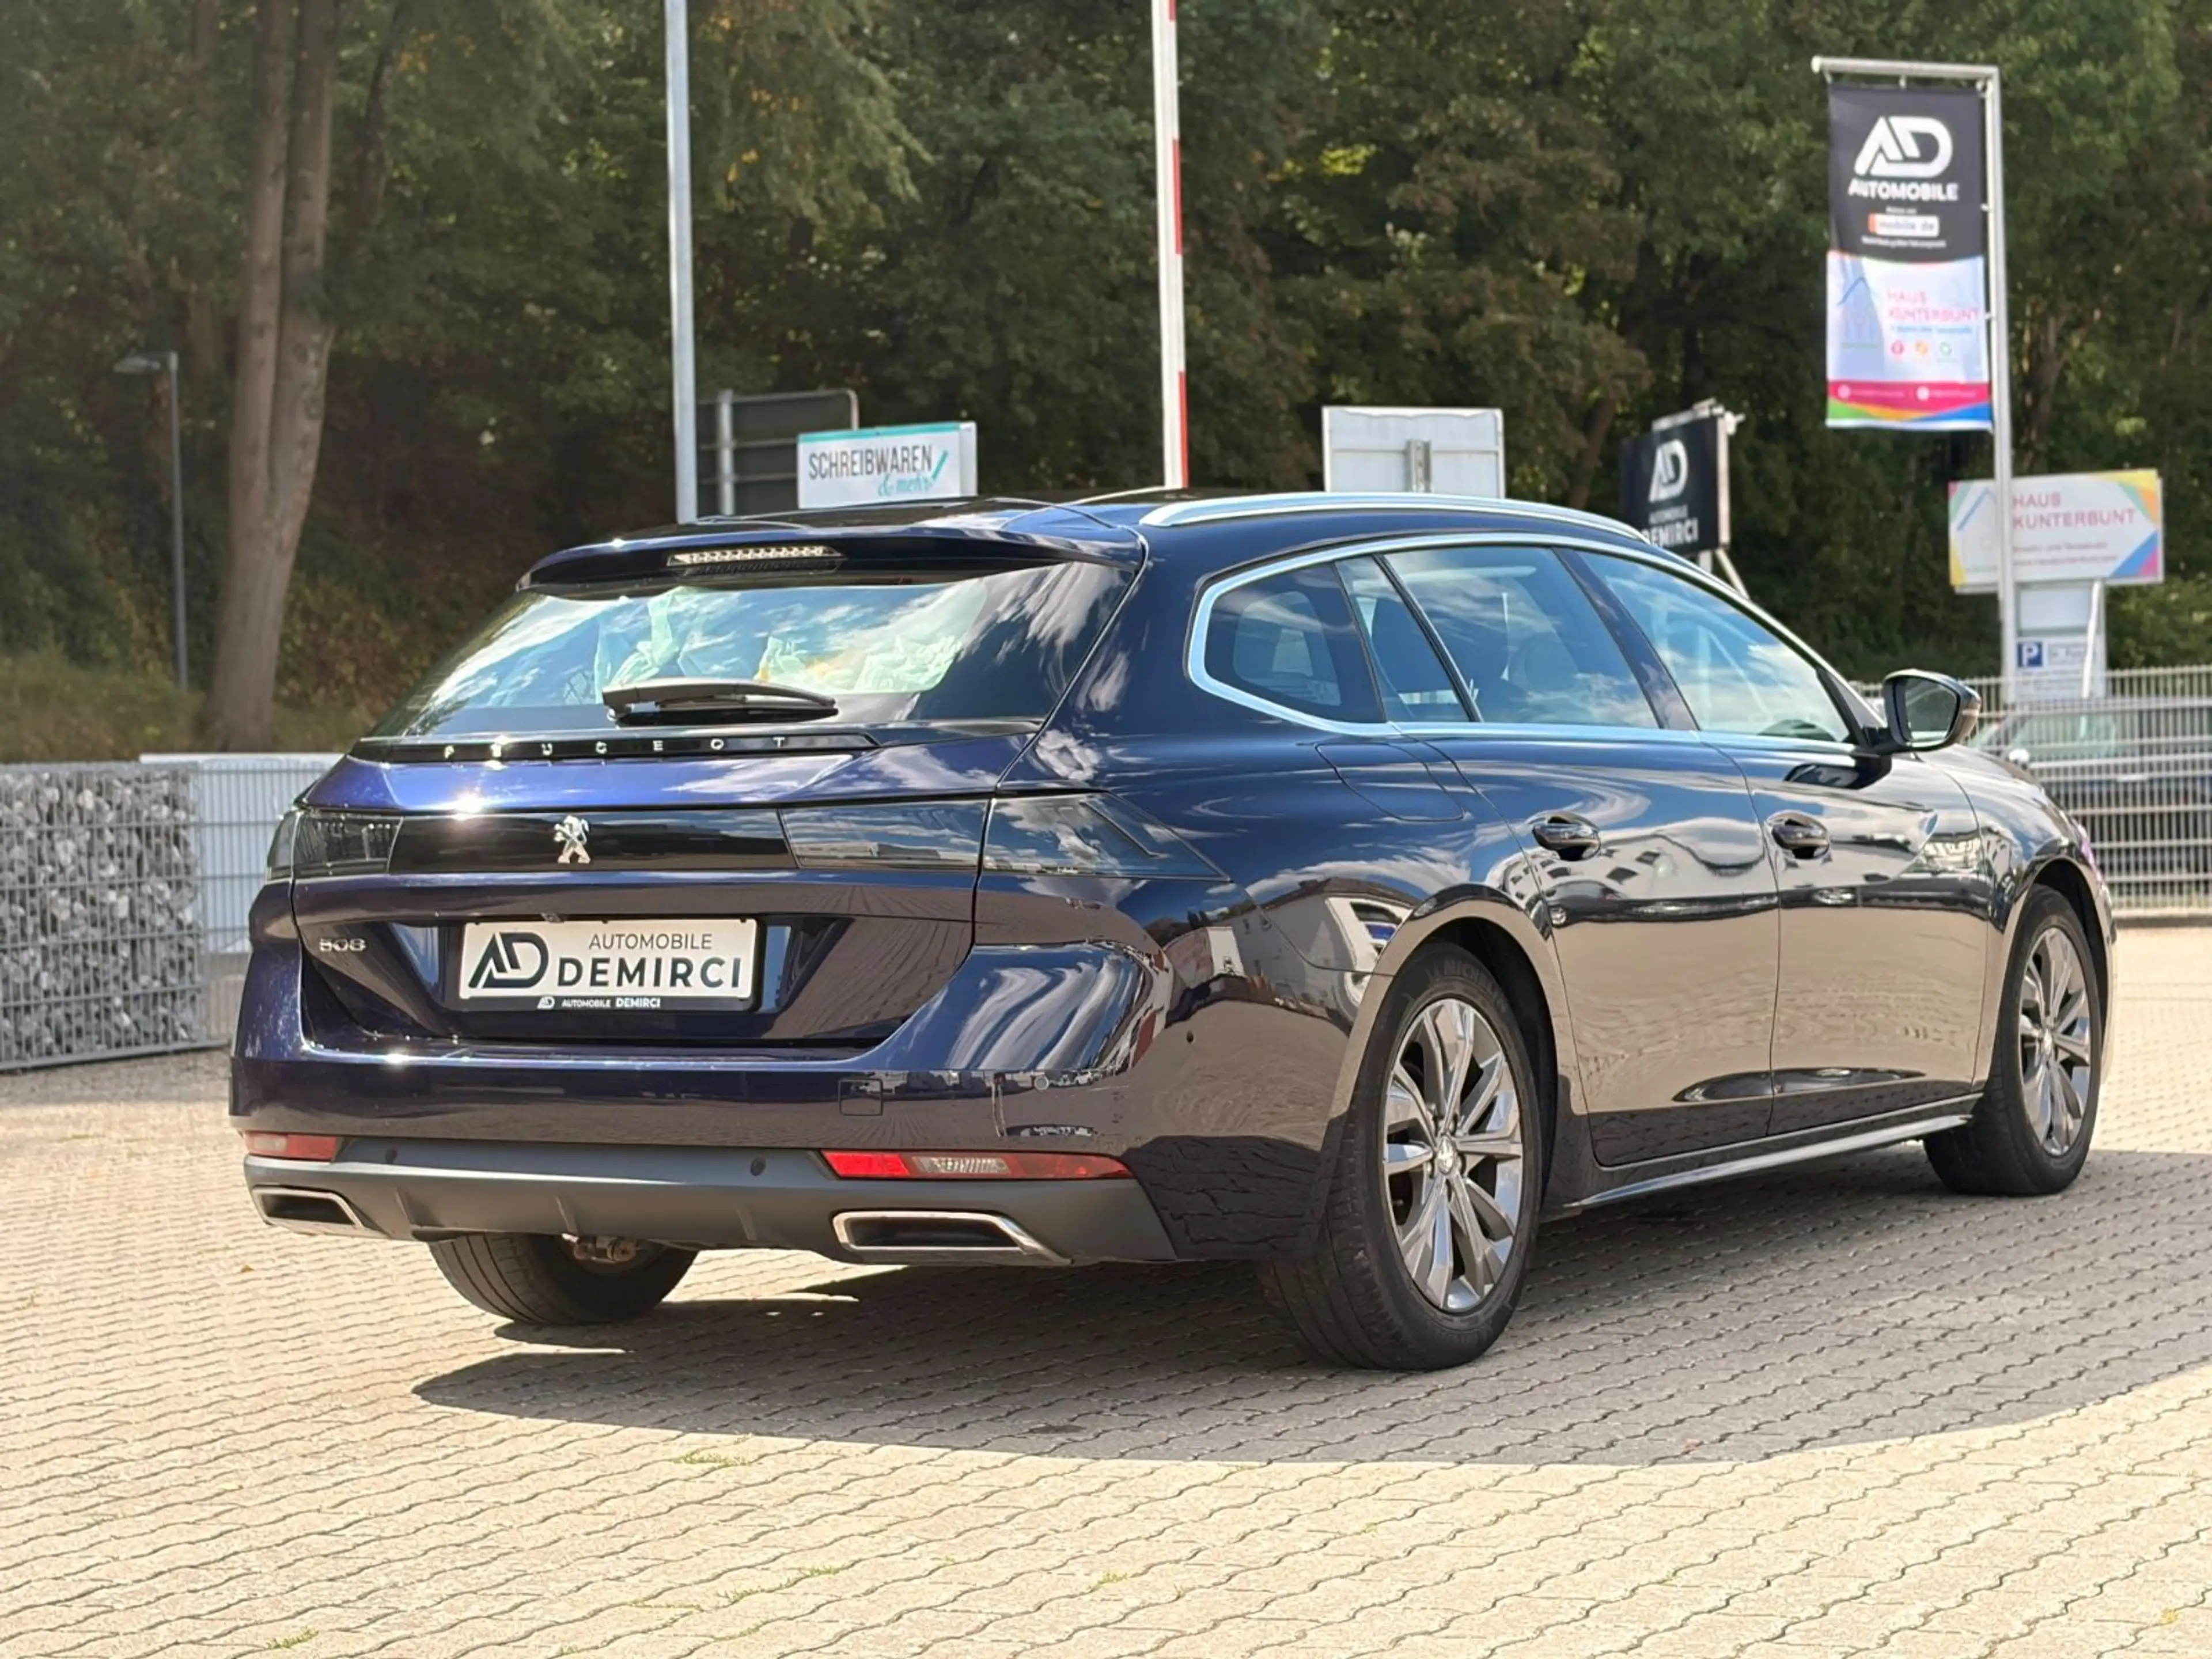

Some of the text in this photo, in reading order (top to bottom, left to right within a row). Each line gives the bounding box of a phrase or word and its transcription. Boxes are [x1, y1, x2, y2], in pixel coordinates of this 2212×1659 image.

[1854, 115, 1953, 178] AD
[1847, 177, 1959, 201] AUTOMOBILE
[809, 445, 932, 479] SCHREIBWAREN
[319, 938, 366, 952] 508
[468, 932, 713, 988] AD AUTOMOBILE
[558, 957, 741, 988] DEMIRCI
[561, 998, 612, 1008] AUTOMOBILE
[615, 997, 661, 1009] DEMIRCI
